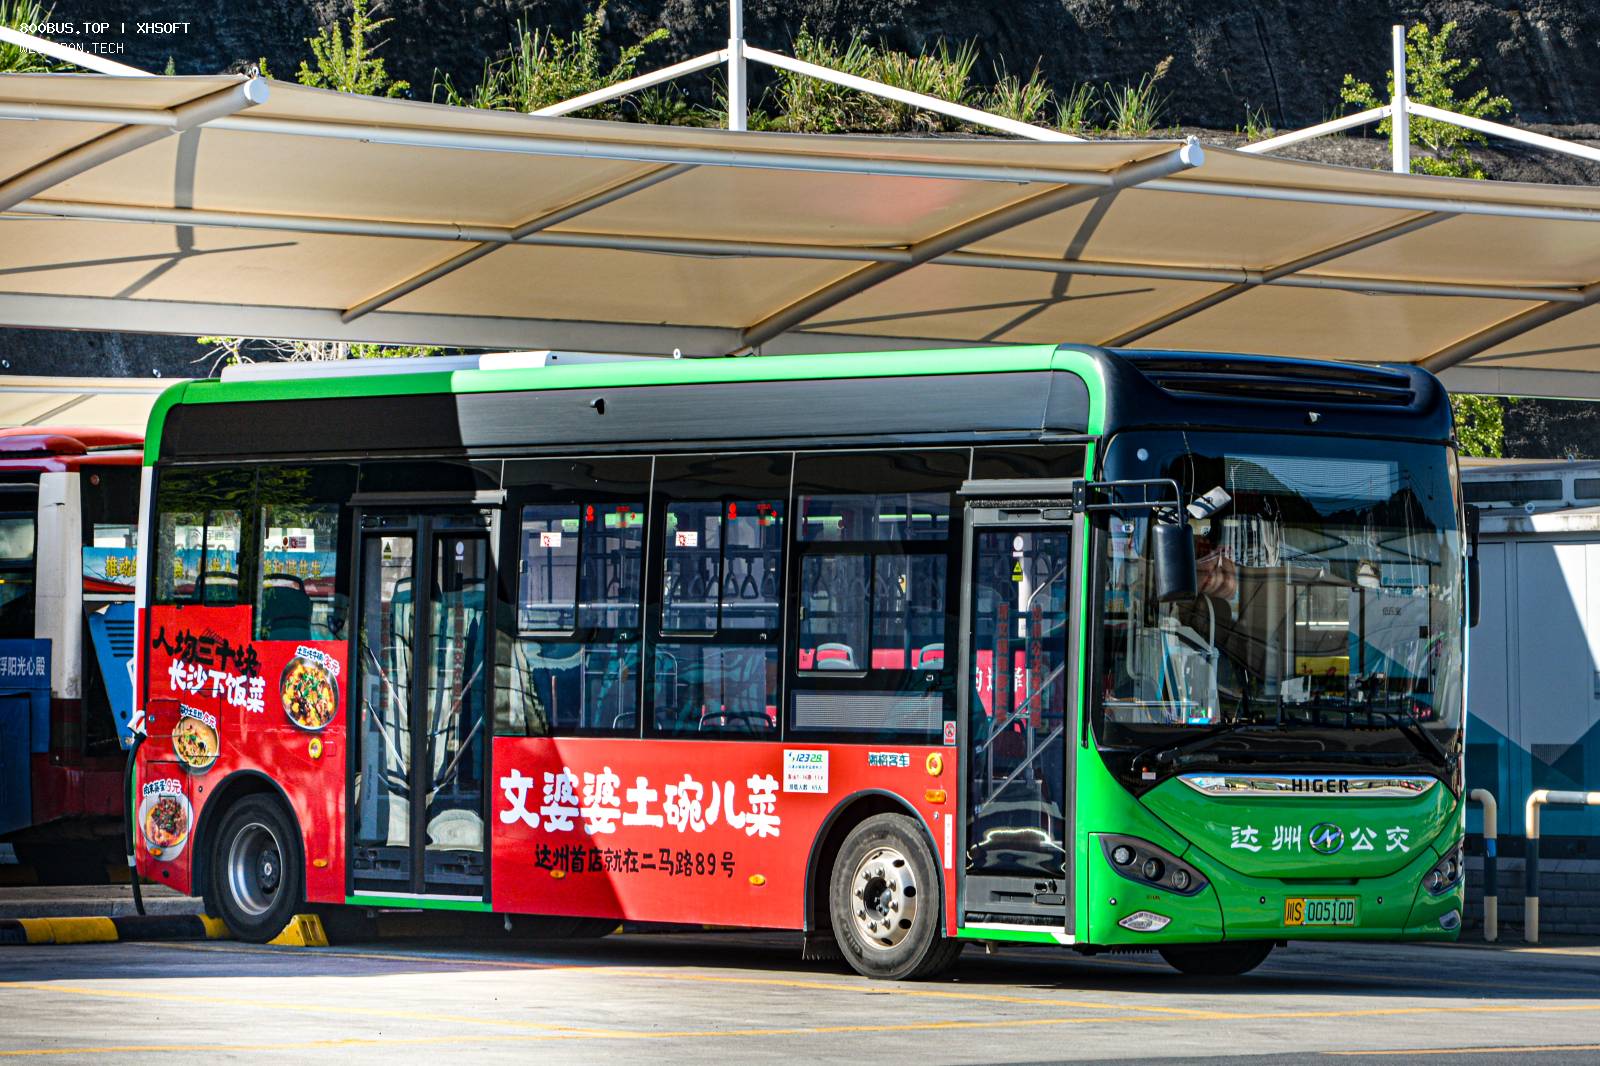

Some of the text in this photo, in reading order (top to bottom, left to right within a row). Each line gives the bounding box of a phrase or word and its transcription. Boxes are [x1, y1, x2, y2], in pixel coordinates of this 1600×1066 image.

[152, 625, 262, 678] 人均三十块
[168, 658, 266, 714] 长沙下饭菜
[499, 766, 781, 838] 文婆婆土碗儿菜
[1291, 778, 1350, 793] HIGER
[1230, 825, 1411, 853] 达州 公交
[534, 844, 736, 878] 达州首店就在二马路89号
